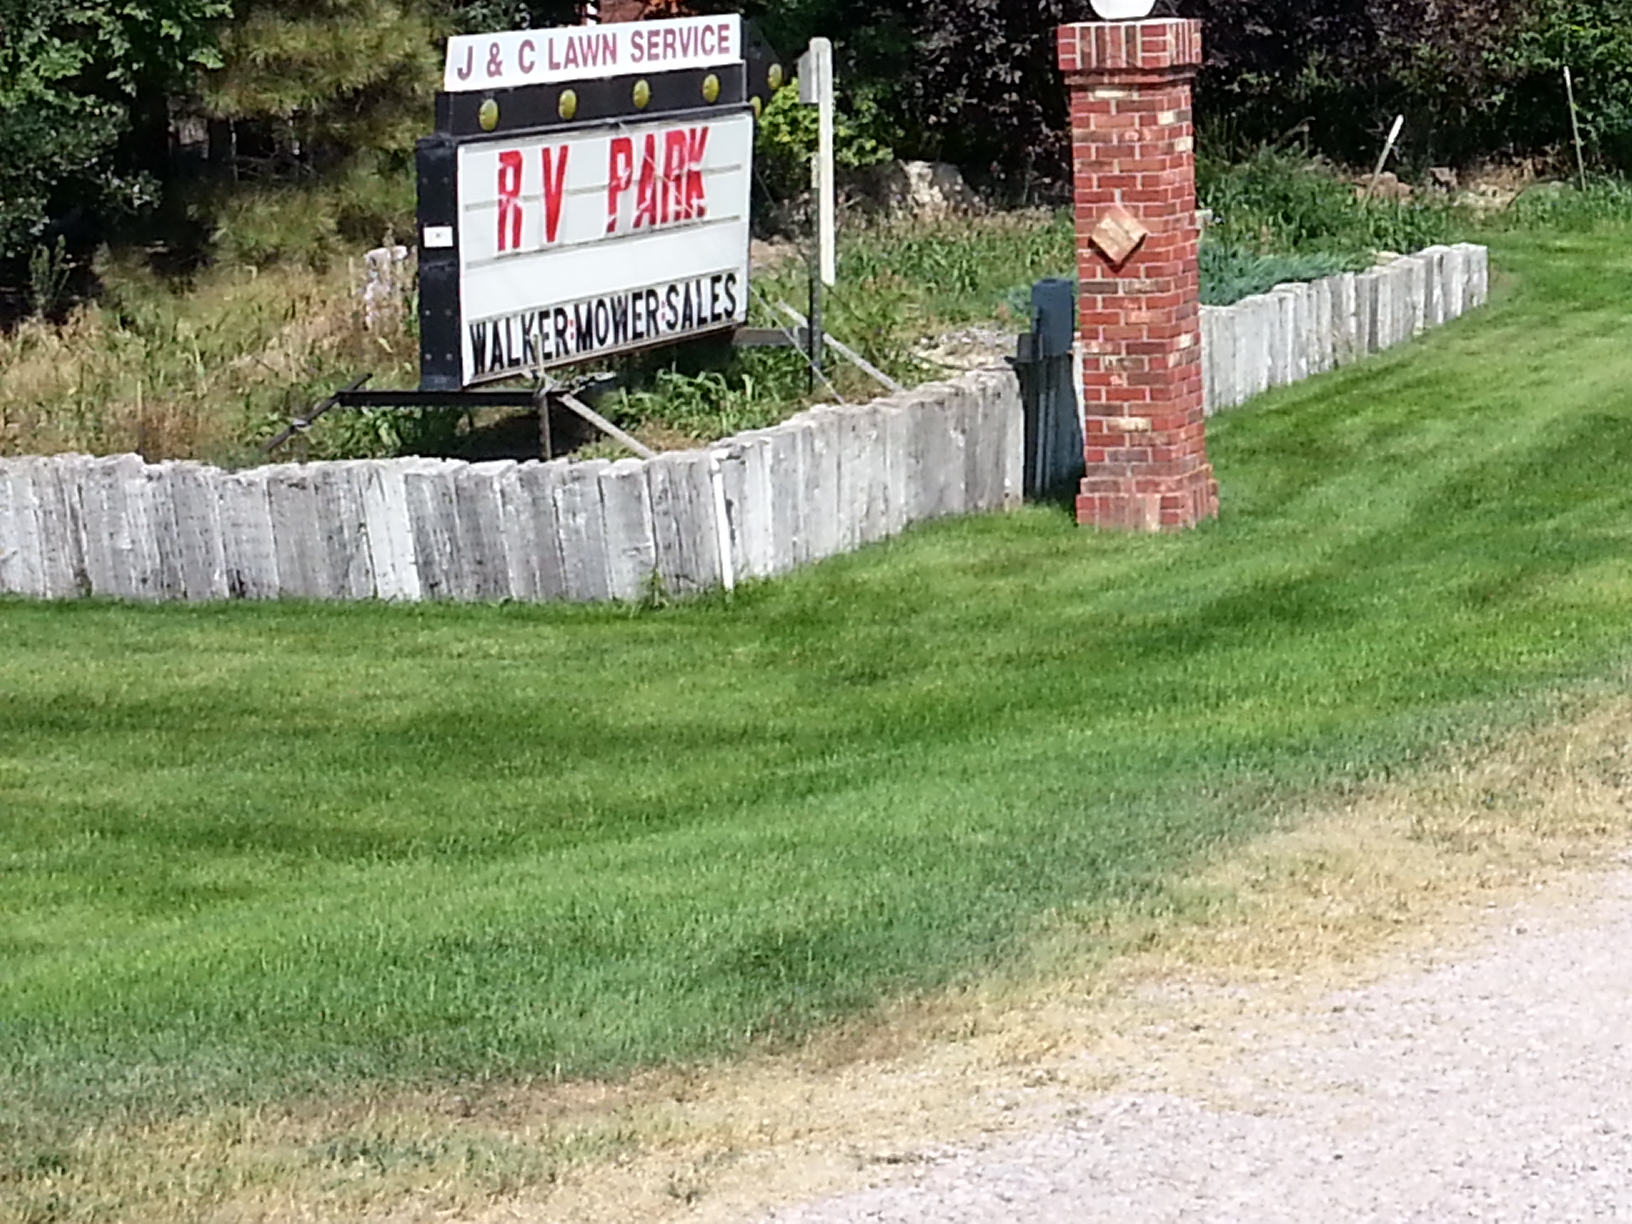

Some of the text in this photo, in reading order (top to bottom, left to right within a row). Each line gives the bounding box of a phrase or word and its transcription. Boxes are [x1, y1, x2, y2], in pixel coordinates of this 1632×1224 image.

[457, 23, 731, 81] J & C LAWN SERVICE
[606, 126, 710, 233] PARK
[469, 272, 738, 376] WALKER MOWER SALES
